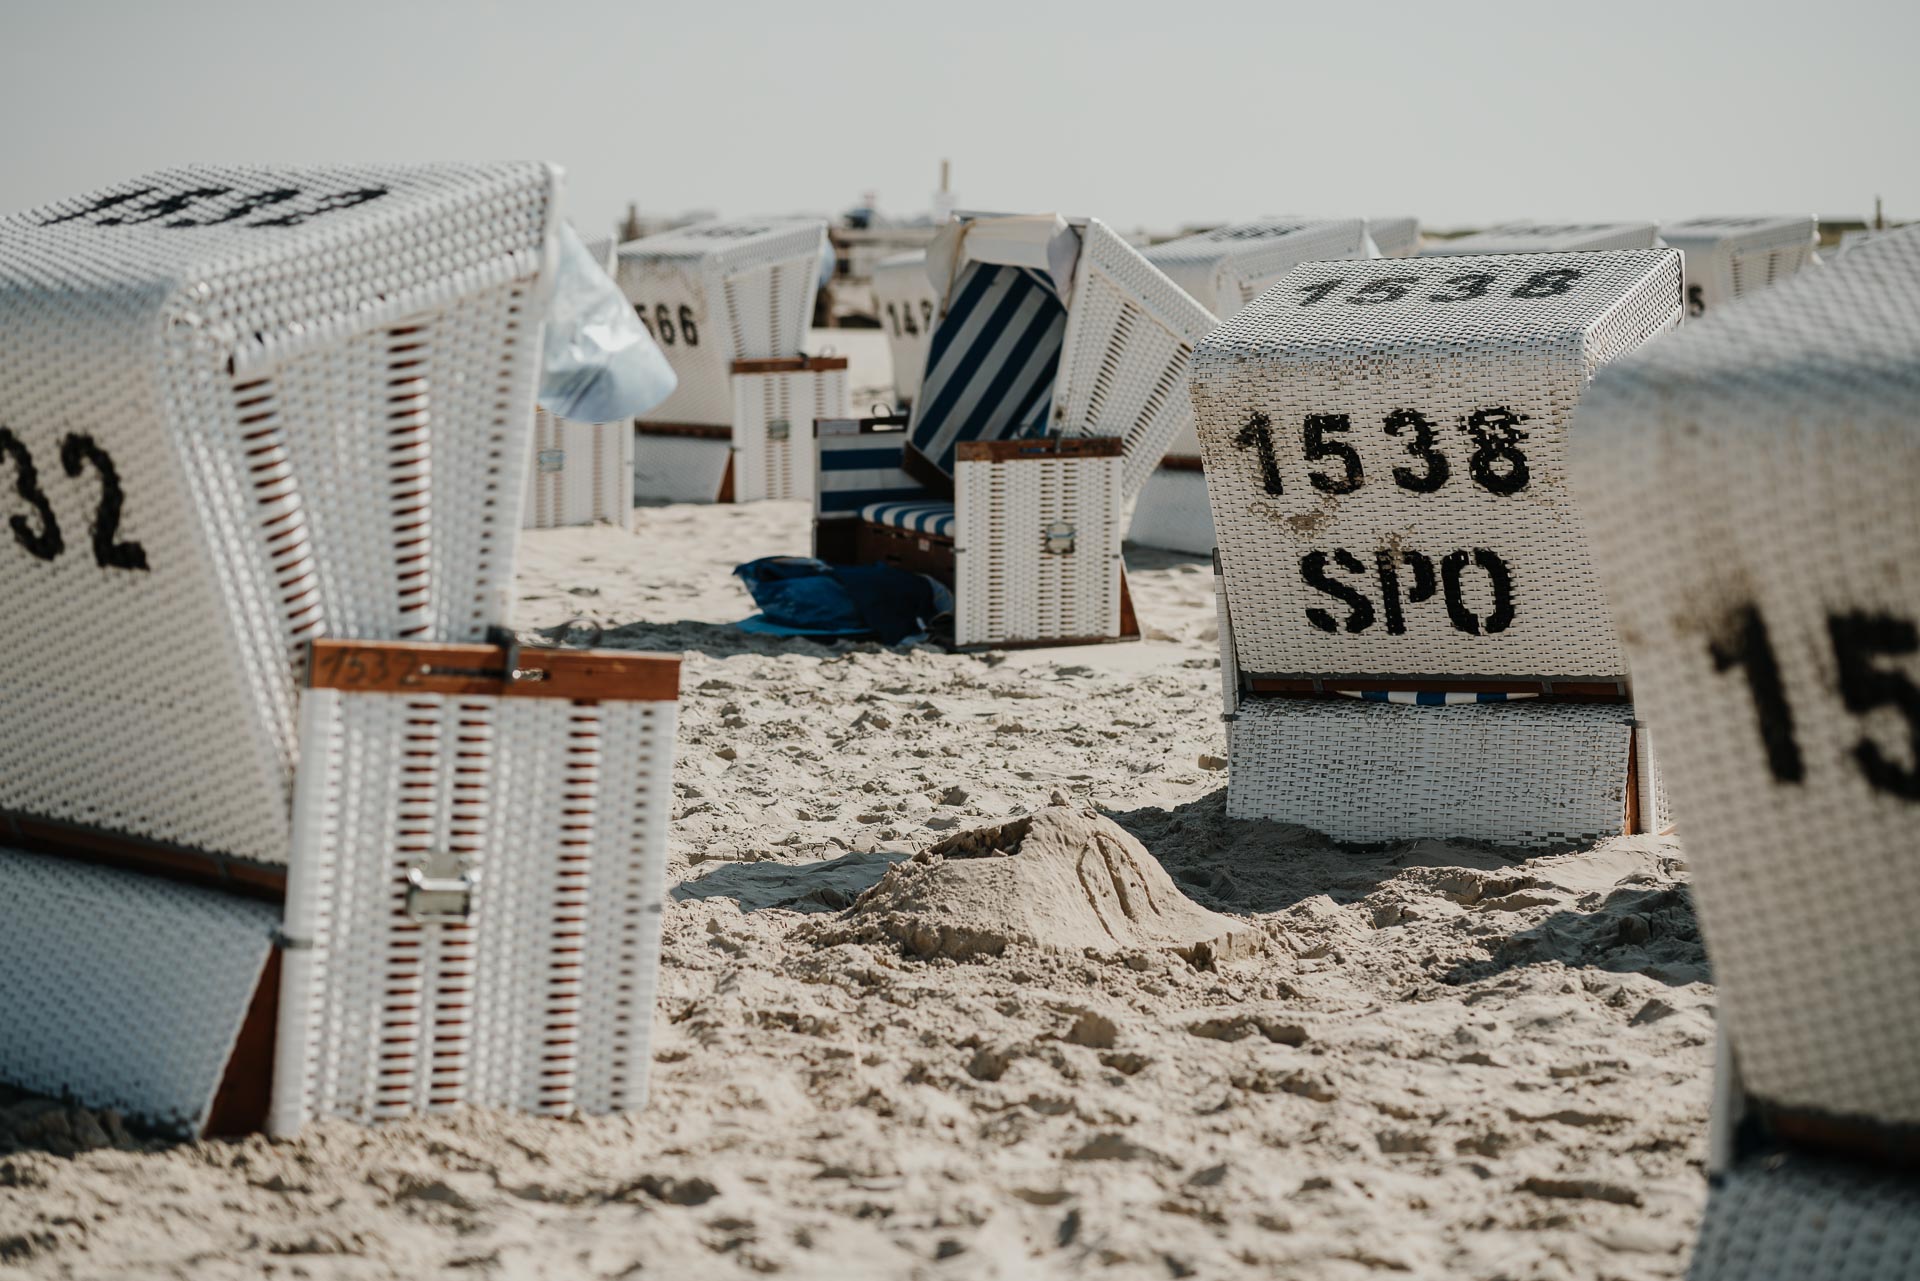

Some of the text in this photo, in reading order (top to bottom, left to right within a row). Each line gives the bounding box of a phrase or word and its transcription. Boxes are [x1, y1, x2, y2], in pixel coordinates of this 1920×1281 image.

[1299, 268, 1584, 306] 1538
[1235, 406, 1530, 495] 1538
[0, 427, 151, 572] 32
[1301, 549, 1515, 636] SPO
[320, 646, 424, 687] 1532
[1704, 601, 1920, 803] 15
